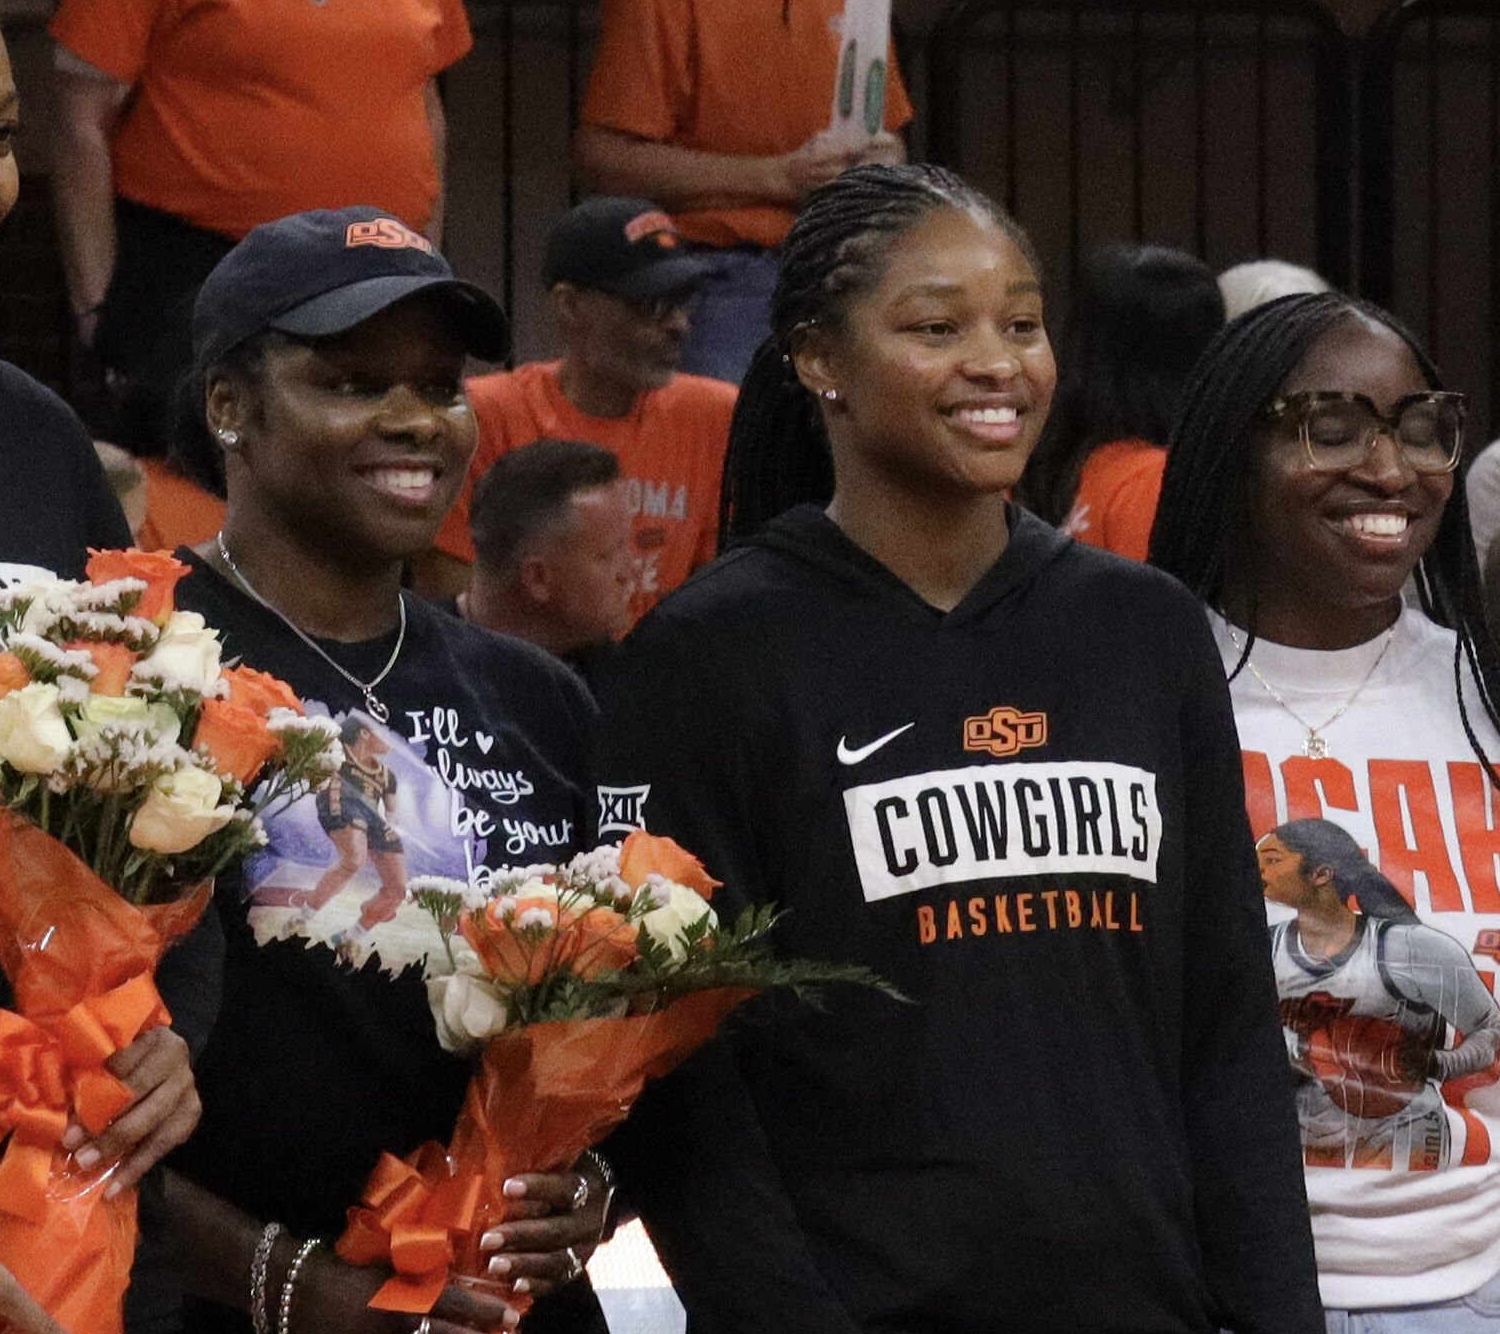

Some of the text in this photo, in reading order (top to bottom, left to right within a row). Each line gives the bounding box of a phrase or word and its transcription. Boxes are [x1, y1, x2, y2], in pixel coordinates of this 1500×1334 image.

[405, 706, 469, 748] I'll
[963, 706, 1047, 757] OSU
[452, 789, 575, 855] be your
[874, 776, 1149, 878] COWGIRLS
[916, 889, 1144, 945] BASKETBALL
